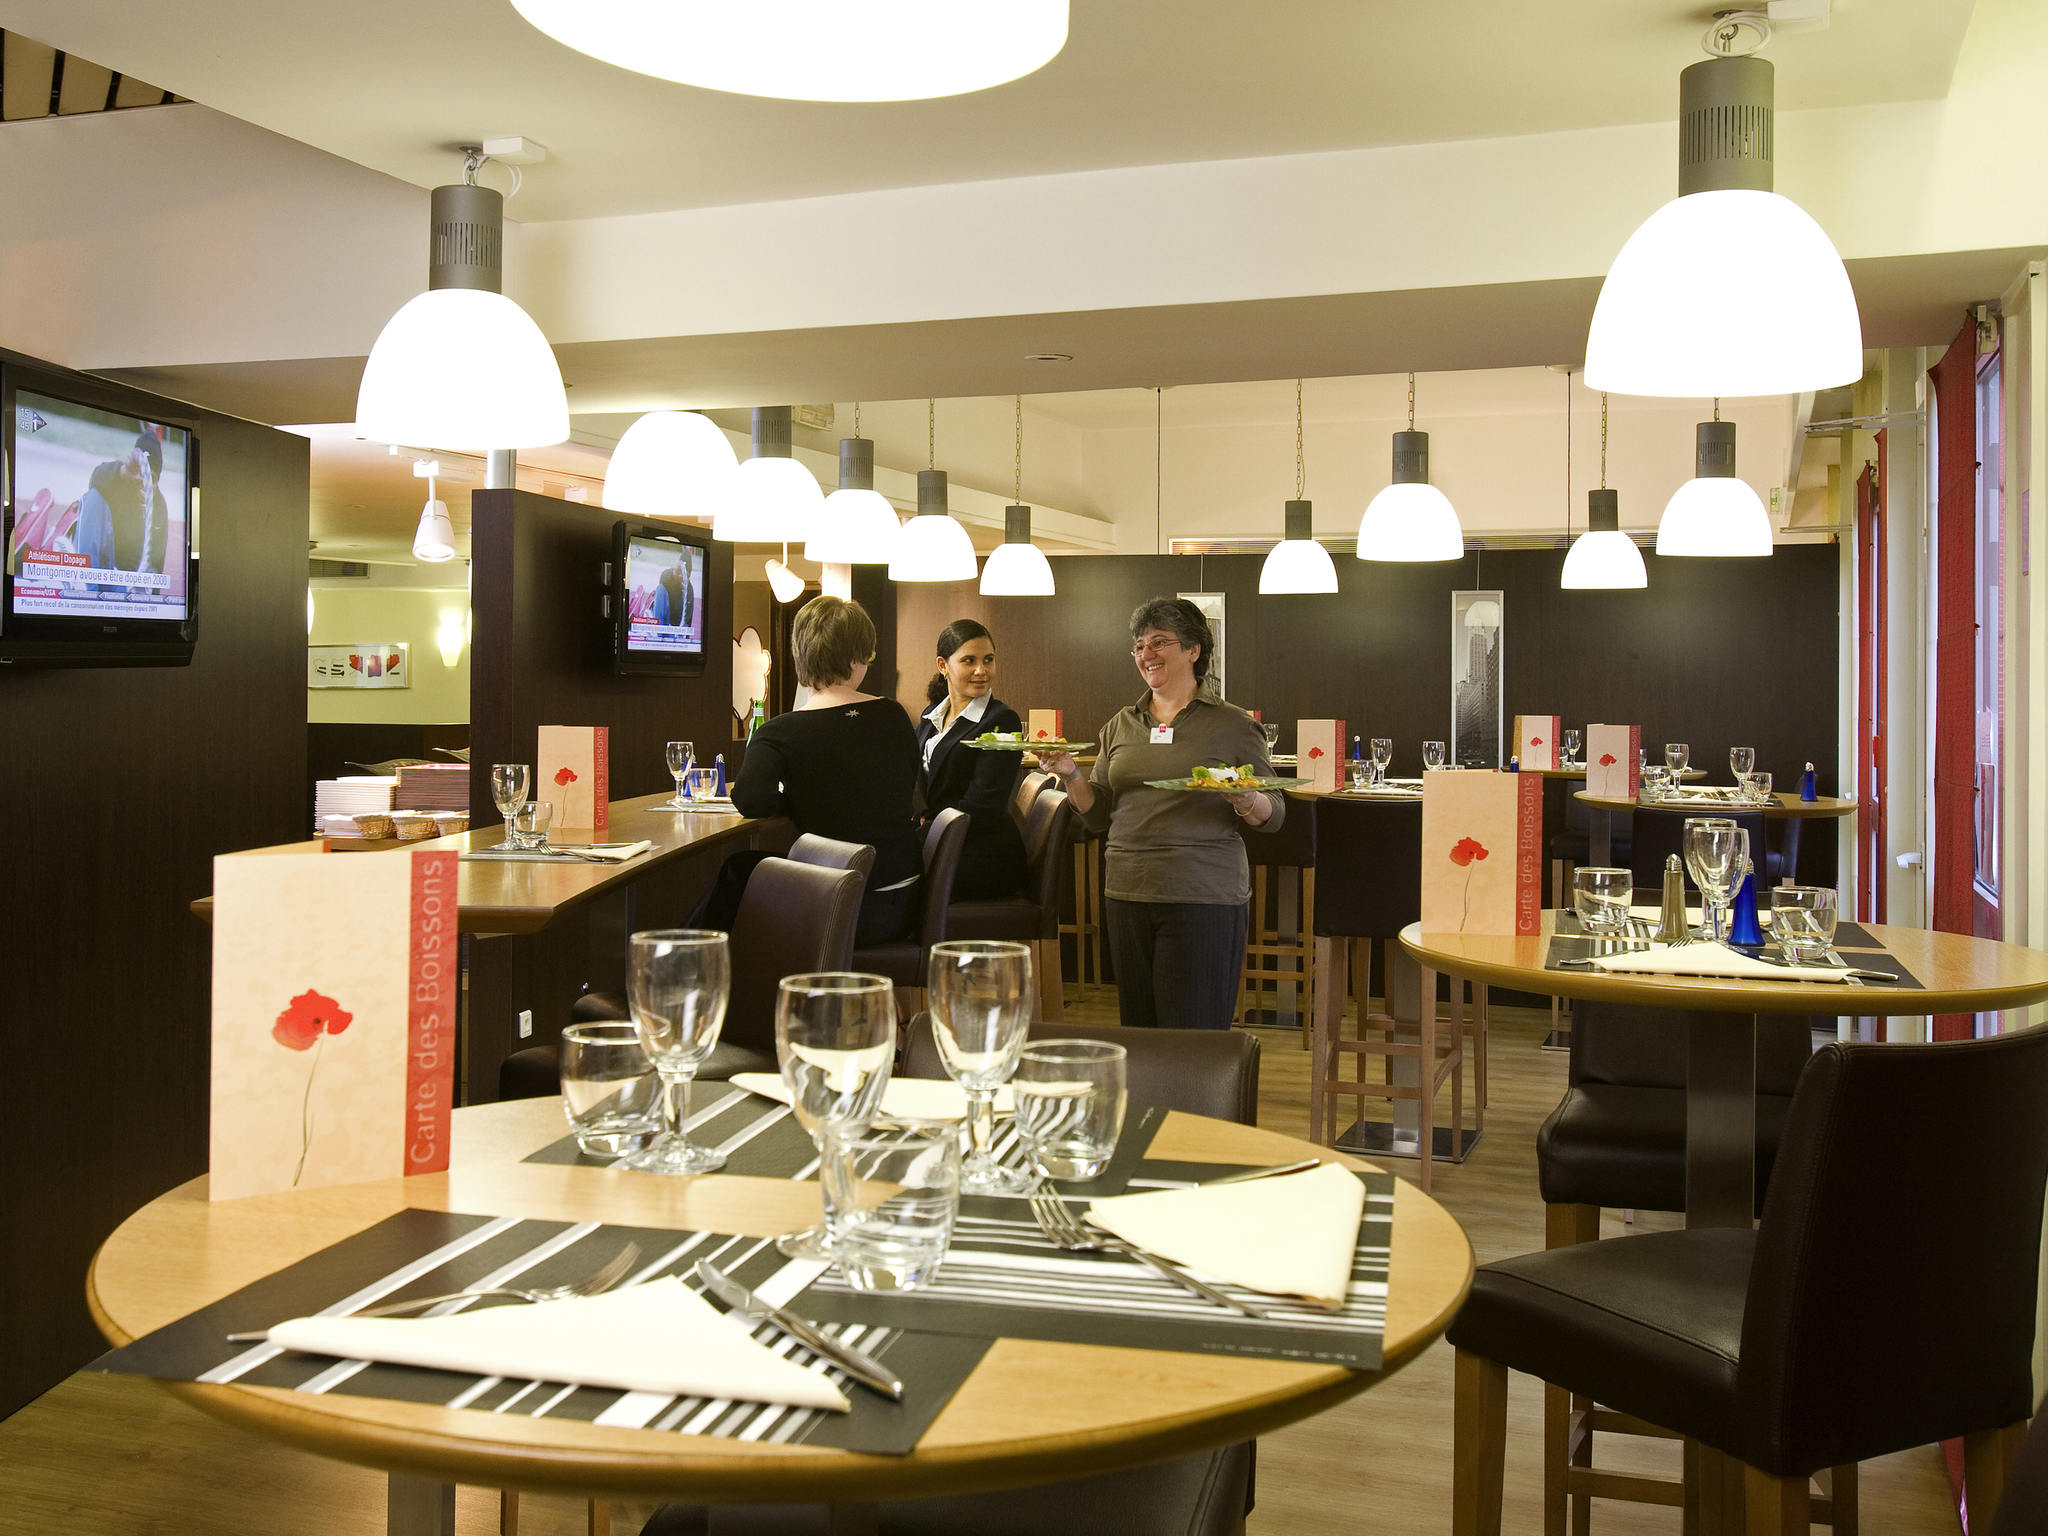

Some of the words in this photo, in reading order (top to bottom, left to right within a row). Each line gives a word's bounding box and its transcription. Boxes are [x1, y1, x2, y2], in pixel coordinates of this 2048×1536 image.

[21, 407, 30, 418] 15
[21, 421, 30, 431] 45
[27, 564, 78, 579] Montgomery
[80, 569, 102, 580] avoue
[143, 576, 152, 584] en
[153, 575, 168, 586] 2000
[64, 554, 86, 566] Dopage
[1521, 778, 1535, 849] Boissons
[1520, 855, 1534, 883] des
[1519, 888, 1533, 931] Carte
[416, 859, 442, 1002] Boissons
[414, 1013, 438, 1069] des
[410, 1082, 436, 1164] Carte
